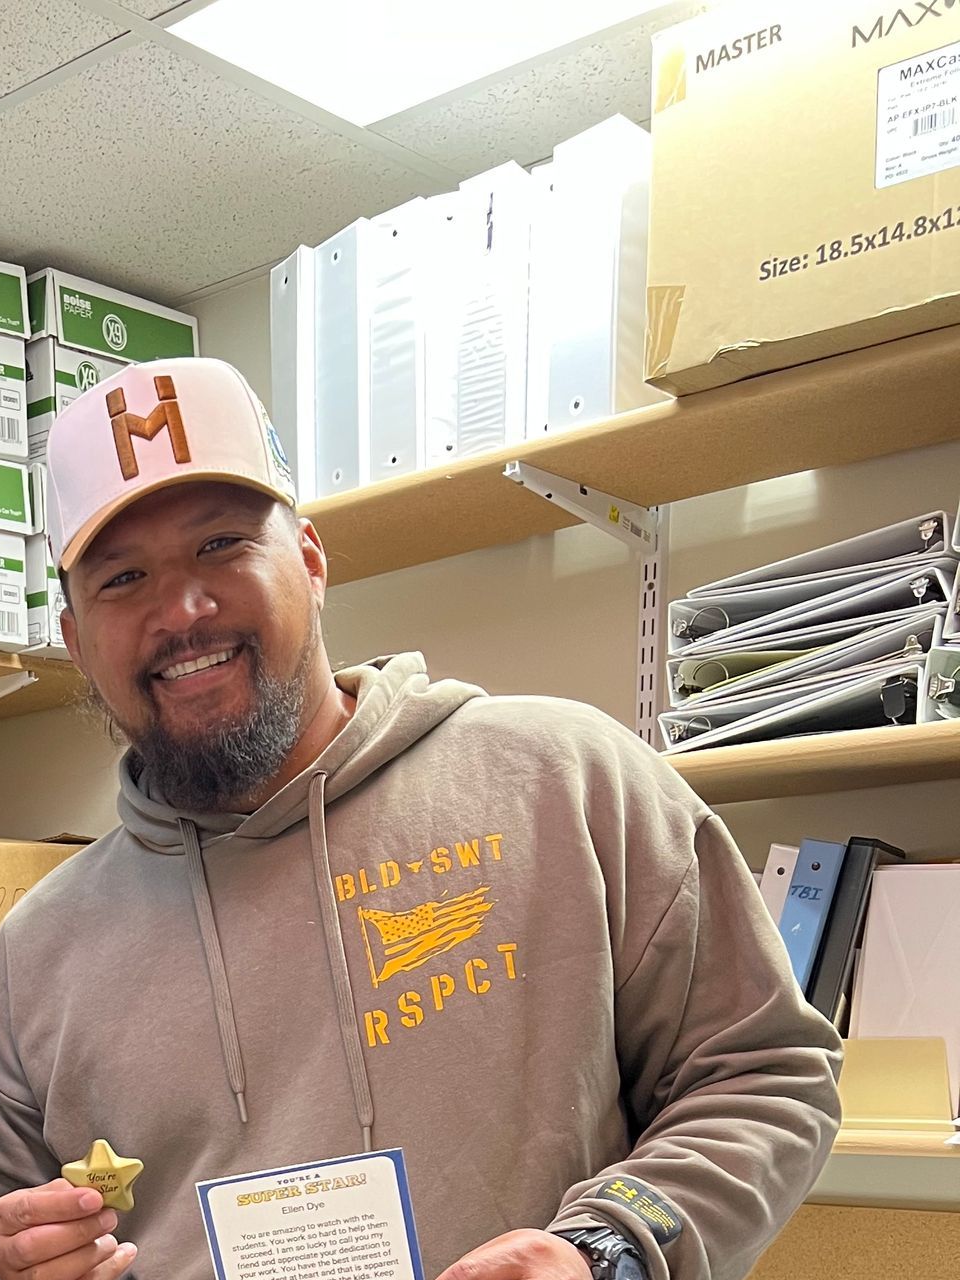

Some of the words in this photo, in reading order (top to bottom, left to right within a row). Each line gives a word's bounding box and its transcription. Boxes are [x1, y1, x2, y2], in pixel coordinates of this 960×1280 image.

[695, 24, 783, 73] MASTER
[759, 253, 809, 281] Size:
[62, 293, 92, 310] BOISE
[64, 304, 93, 319] PAPER
[335, 861, 401, 902] BLD
[430, 834, 503, 874] SWT
[791, 885, 823, 900] TBI
[364, 943, 518, 1047] RSPCT
[86, 1172, 116, 1184] You're
[100, 1184, 118, 1194] Star
[236, 1186, 302, 1206] SUPER
[304, 1172, 367, 1194] STAR!
[276, 1174, 311, 1185] YOU'RE
[280, 1202, 304, 1214] Ellen
[306, 1200, 325, 1211] Dye
[268, 1238, 285, 1246] You
[286, 1233, 306, 1243] work
[318, 1228, 337, 1238] hard
[347, 1224, 366, 1233] help
[366, 1221, 388, 1230] them
[272, 1225, 306, 1236] amazing
[316, 1218, 341, 1228] watch
[342, 1215, 360, 1224] with
[361, 1213, 375, 1221] the
[306, 1240, 327, 1249] lucky
[337, 1235, 353, 1244] call
[354, 1234, 369, 1243] you
[237, 1260, 260, 1270] friend
[261, 1257, 276, 1267] and
[277, 1252, 318, 1264] appreciate
[319, 1249, 337, 1259] your
[338, 1242, 380, 1254] dedication
[239, 1271, 256, 1280] your
[297, 1261, 316, 1271] have
[317, 1259, 331, 1267] the
[331, 1256, 350, 1265] best
[350, 1251, 381, 1262] interest
[382, 1248, 391, 1257] of
[298, 1271, 320, 1280] heart
[320, 1267, 336, 1276] and
[336, 1265, 353, 1274] that
[363, 1258, 399, 1270] apparent
[373, 1269, 394, 1278] Keep
